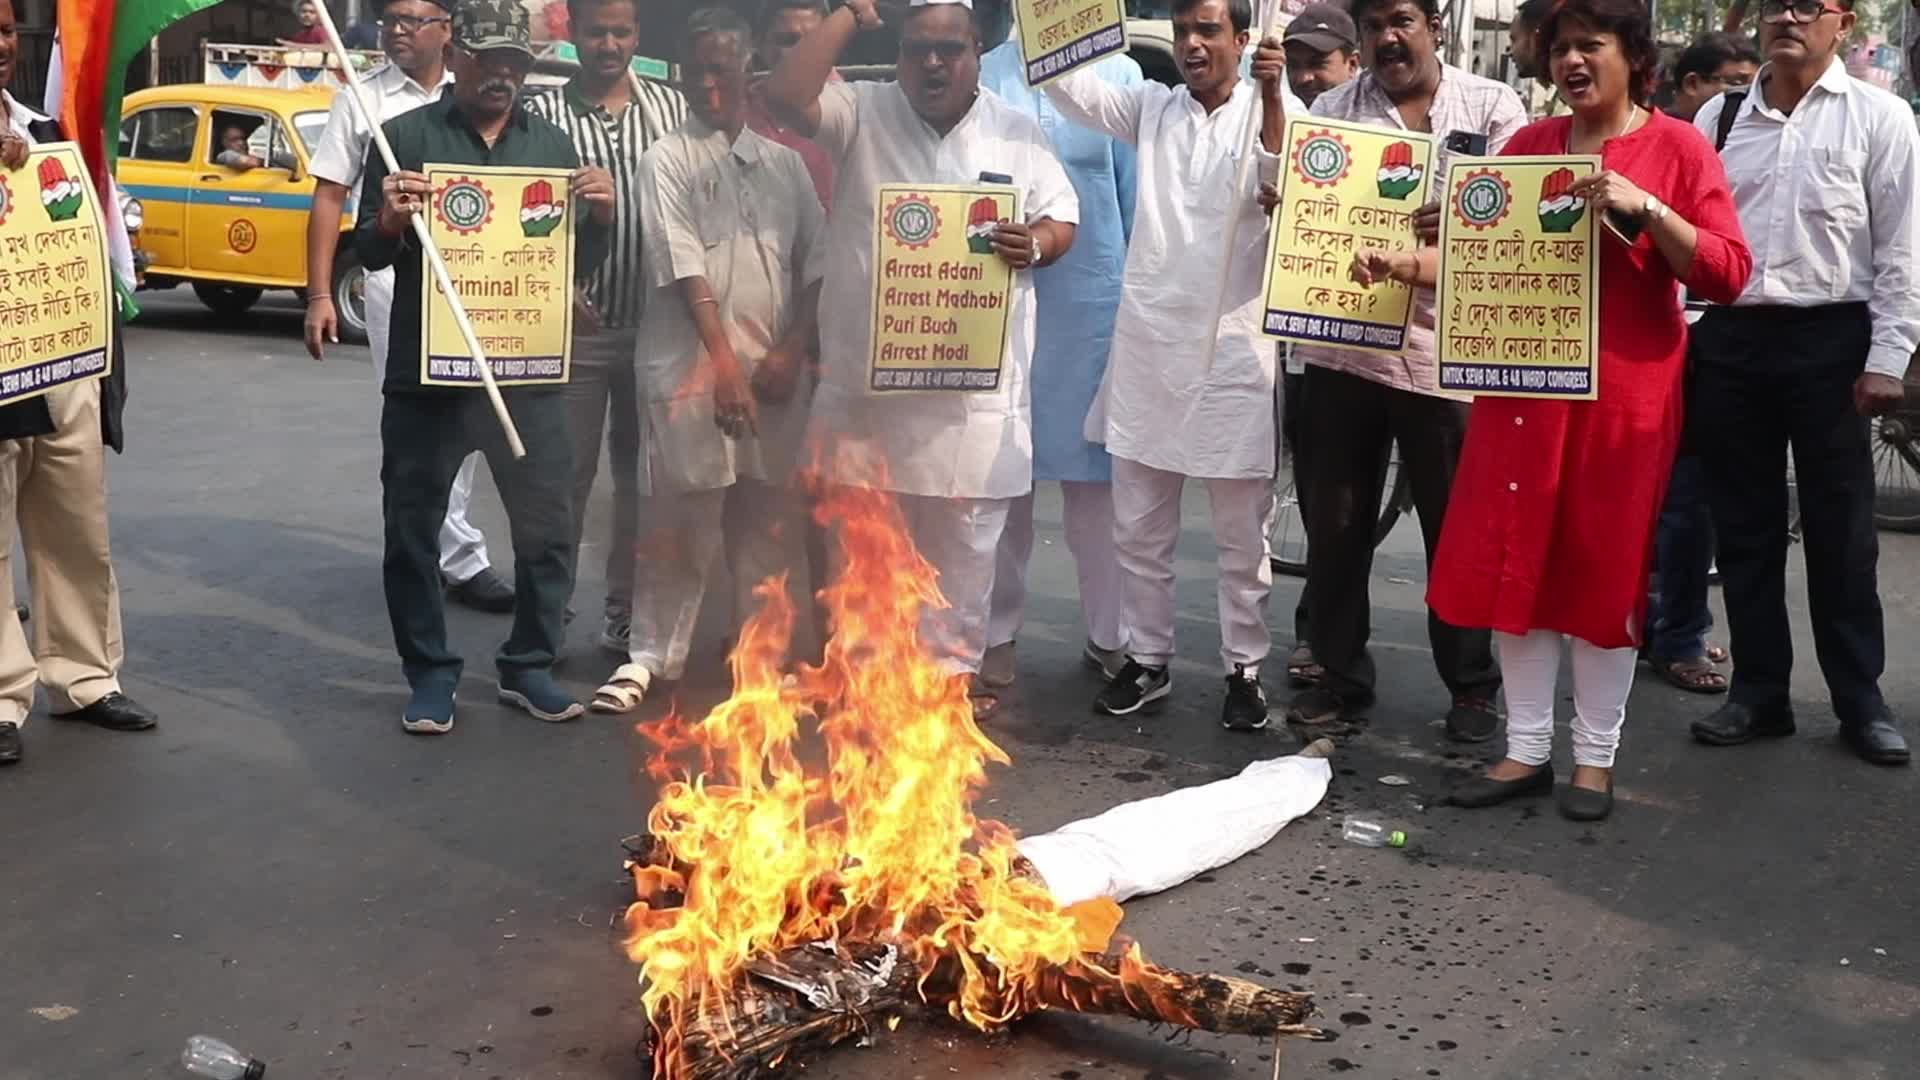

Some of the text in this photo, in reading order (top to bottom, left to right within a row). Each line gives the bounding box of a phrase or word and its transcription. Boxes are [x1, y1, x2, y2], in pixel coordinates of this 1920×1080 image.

[1295, 193, 1414, 231] মোদী তোমার
[35, 227, 78, 253] দেখবে
[80, 225, 96, 245] না
[1293, 219, 1354, 252] কিসের
[1451, 238, 1488, 261] নরেন্দ্র
[1494, 229, 1525, 262] মোদী
[16, 263, 53, 289] সবাই
[885, 259, 983, 281] Arrest Adani
[1278, 251, 1338, 281] আদানি
[885, 287, 1003, 309] Arrest Madhabi
[1305, 286, 1332, 307] কে
[1336, 289, 1362, 313] হয়
[1545, 273, 1583, 299] কাছে
[42, 290, 71, 320] নীতি
[1468, 302, 1503, 328] দেখো
[1507, 304, 1547, 332] কাপড়
[1551, 305, 1581, 334] খুলে
[883, 315, 957, 334] Puri Buch
[1266, 312, 1289, 331] INTUC
[1289, 315, 1307, 334] SEVA
[1341, 322, 1364, 343] WARD
[1364, 325, 1403, 347] CONGRESS
[30, 333, 55, 354] আর
[881, 342, 969, 360] Arrest Modi
[1448, 326, 1497, 358] বিজেপি
[1503, 335, 1547, 361] নেতারা
[1442, 366, 1588, 390] INTUC SEVA DAL & 48 WARD CONGRESS
